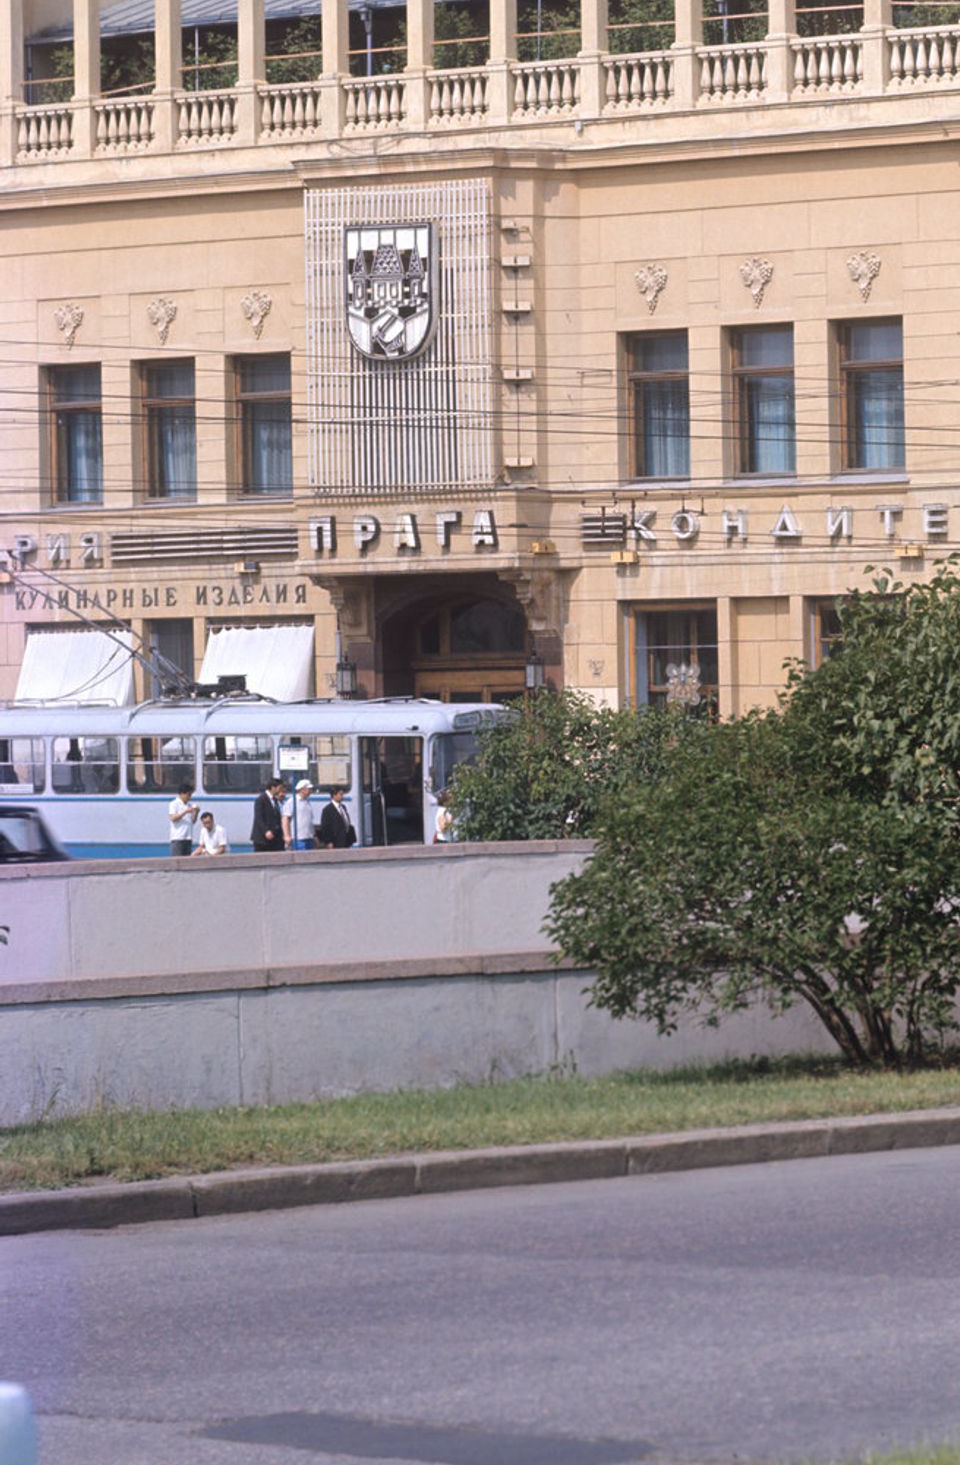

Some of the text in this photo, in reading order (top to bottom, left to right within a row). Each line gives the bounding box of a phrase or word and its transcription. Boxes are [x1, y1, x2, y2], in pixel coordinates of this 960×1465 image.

[309, 510, 498, 552] ПРАГА
[15, 583, 307, 611] КУЛИНАРНЫЕ ИЗДЕЛИЯ
